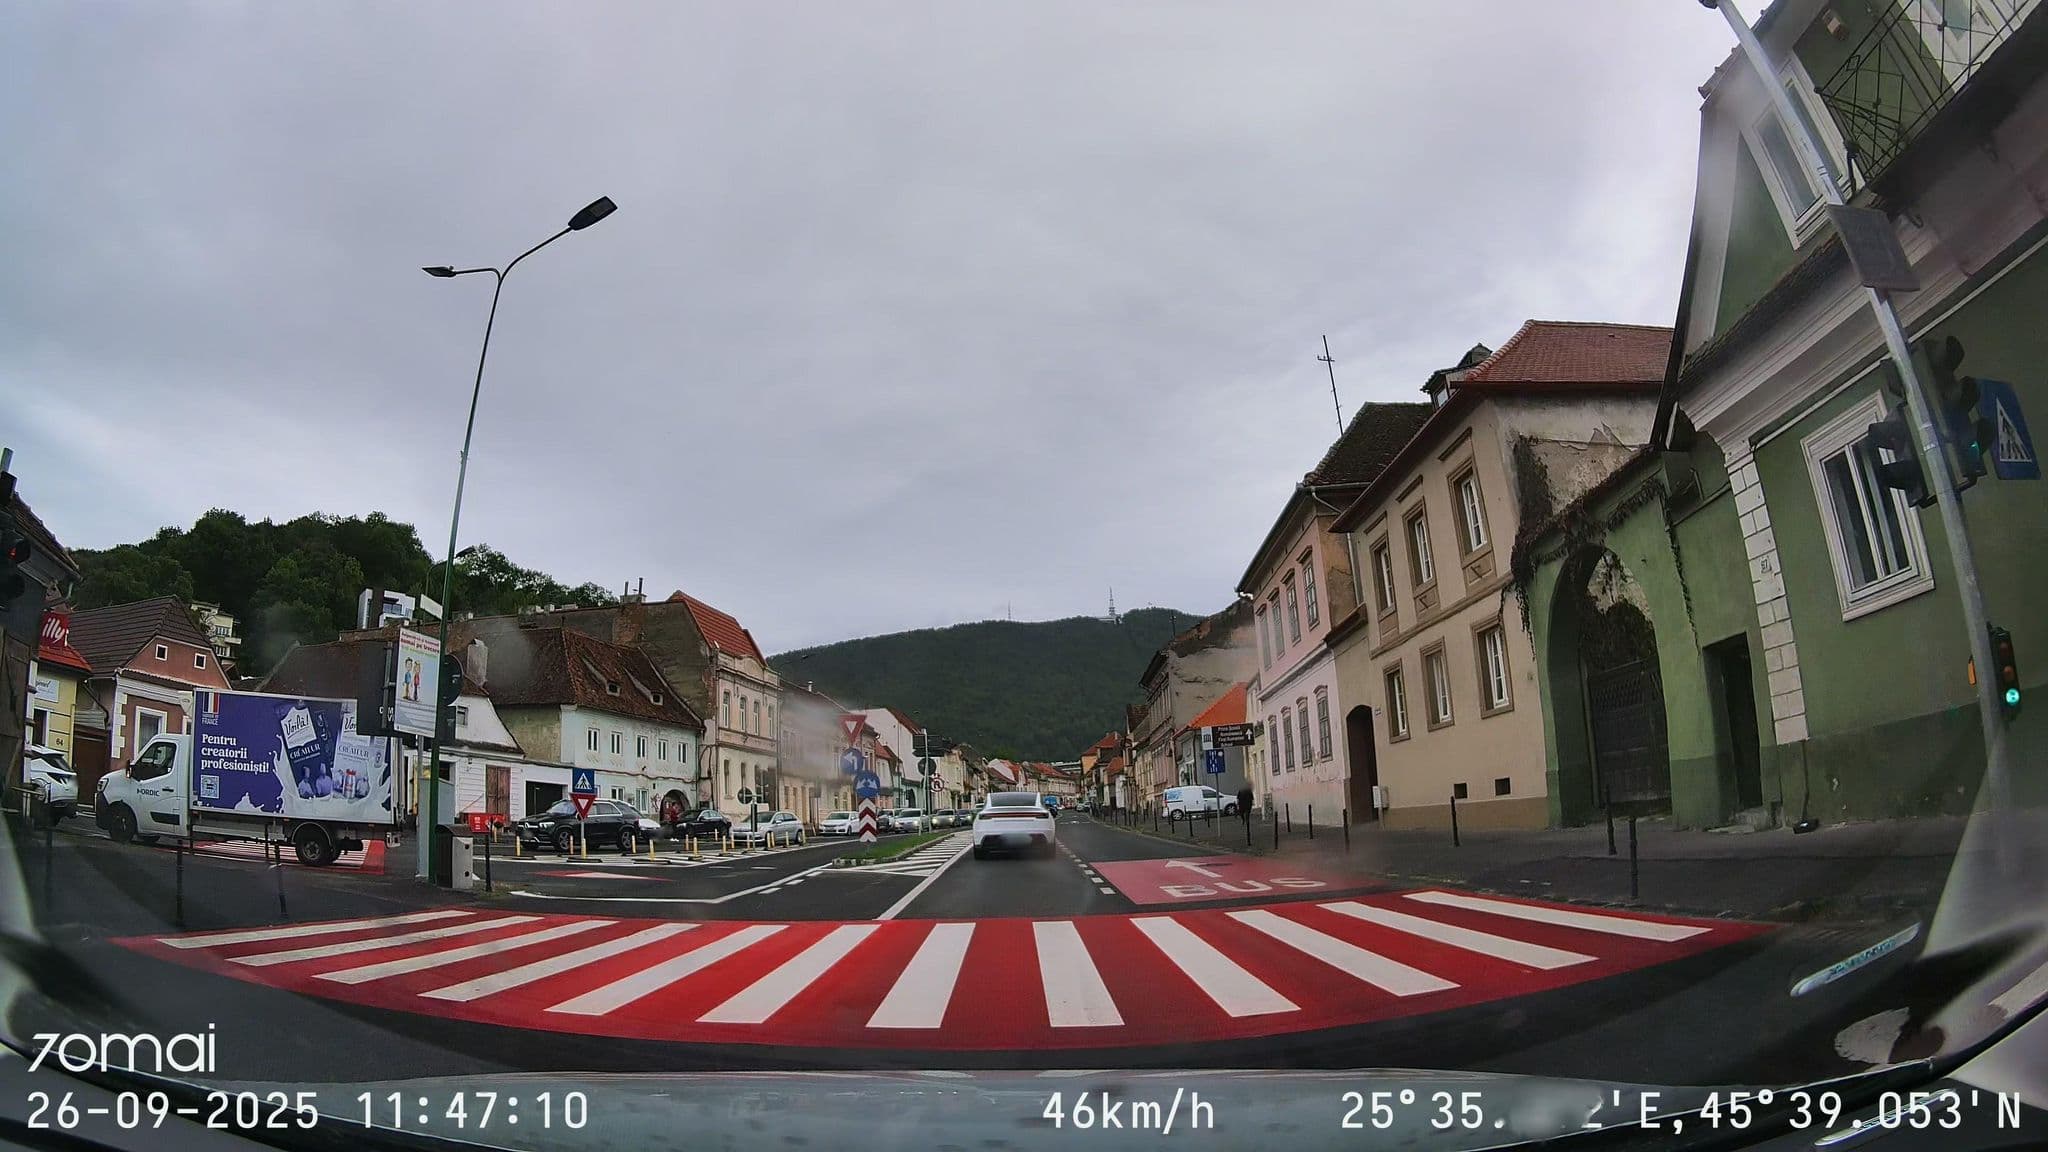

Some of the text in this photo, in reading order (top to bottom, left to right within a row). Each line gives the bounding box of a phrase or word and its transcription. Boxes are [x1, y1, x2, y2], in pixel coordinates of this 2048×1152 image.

[42, 618, 66, 644] illy
[202, 733, 237, 746] Pentru
[201, 747, 248, 759] creatorii
[201, 759, 269, 775] profesioniști!
[136, 788, 160, 797] NORDIC
[1159, 876, 1328, 898] BUS
